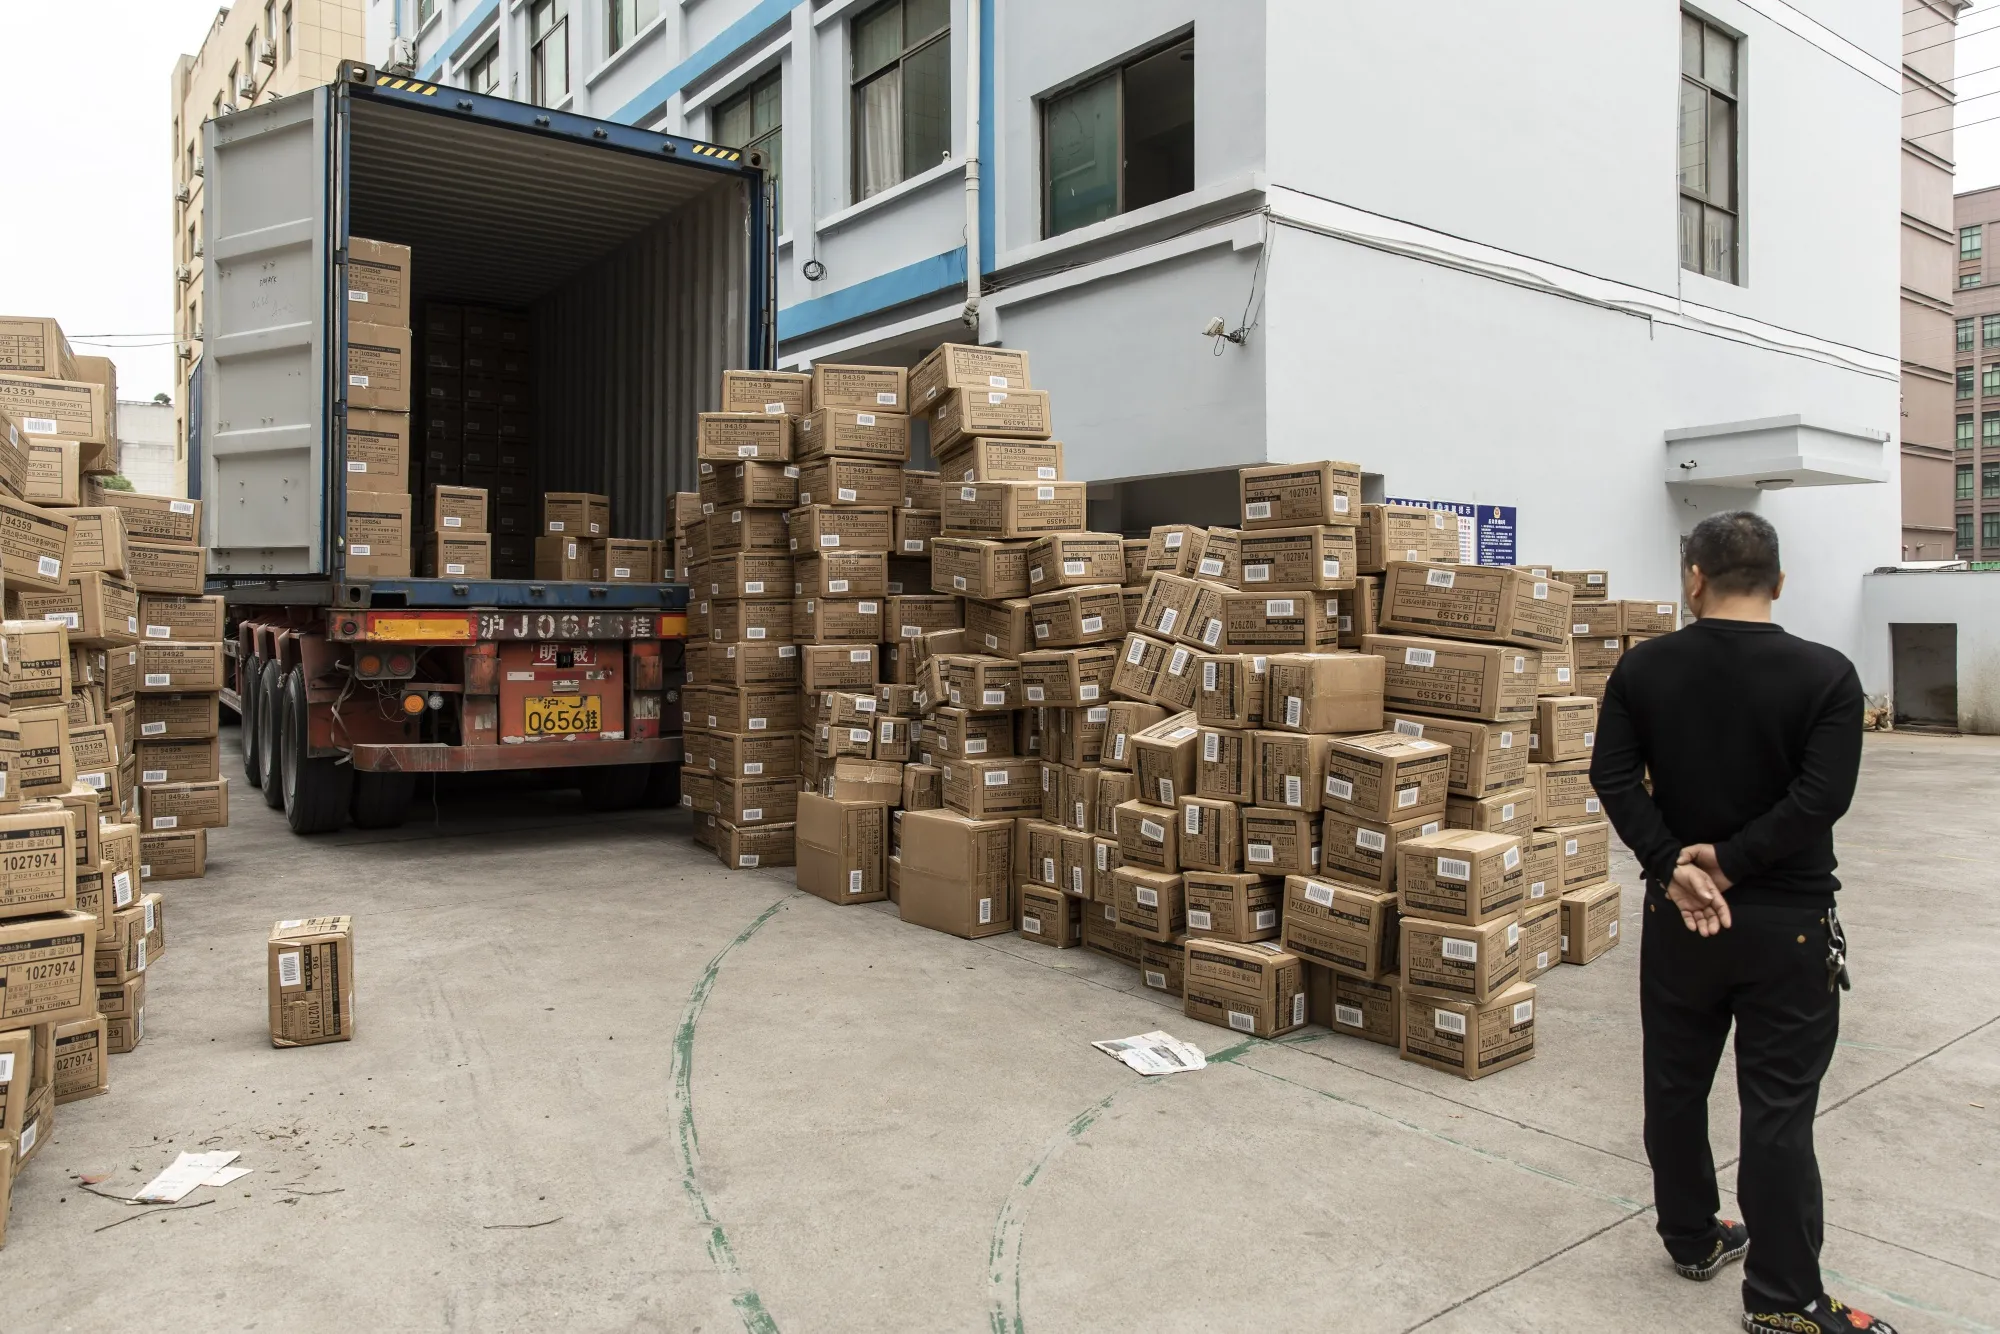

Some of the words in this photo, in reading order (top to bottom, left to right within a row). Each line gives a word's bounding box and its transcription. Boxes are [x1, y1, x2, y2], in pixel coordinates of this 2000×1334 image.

[1289, 487, 1317, 498] 1027974
[6, 517, 32, 531] 94359
[131, 552, 159, 560] 94925
[1283, 552, 1309, 562] 1027974
[1437, 611, 1469, 621] 94359
[1231, 620, 1257, 629] 1027974
[1417, 690, 1451, 701] 94359
[529, 710, 597, 731] 0656挂
[1359, 775, 1378, 788] 1027974
[1428, 771, 1445, 784] 1027974
[4, 853, 57, 871] 1027974
[1408, 879, 1429, 891] 1027974
[1483, 880, 1499, 895] 1027974
[1292, 901, 1319, 914] 1027974
[313, 956, 319, 970] 96
[1412, 957, 1435, 970] 1027974
[26, 960, 76, 981] 1027974
[34, 978, 74, 989] 2021-07-15
[12, 1007, 32, 1015] MADE
[47, 1000, 71, 1008] CHINA
[1232, 1002, 1259, 1015] 1027974
[308, 1002, 320, 1034] 1027974
[1482, 1033, 1503, 1047] 1027974
